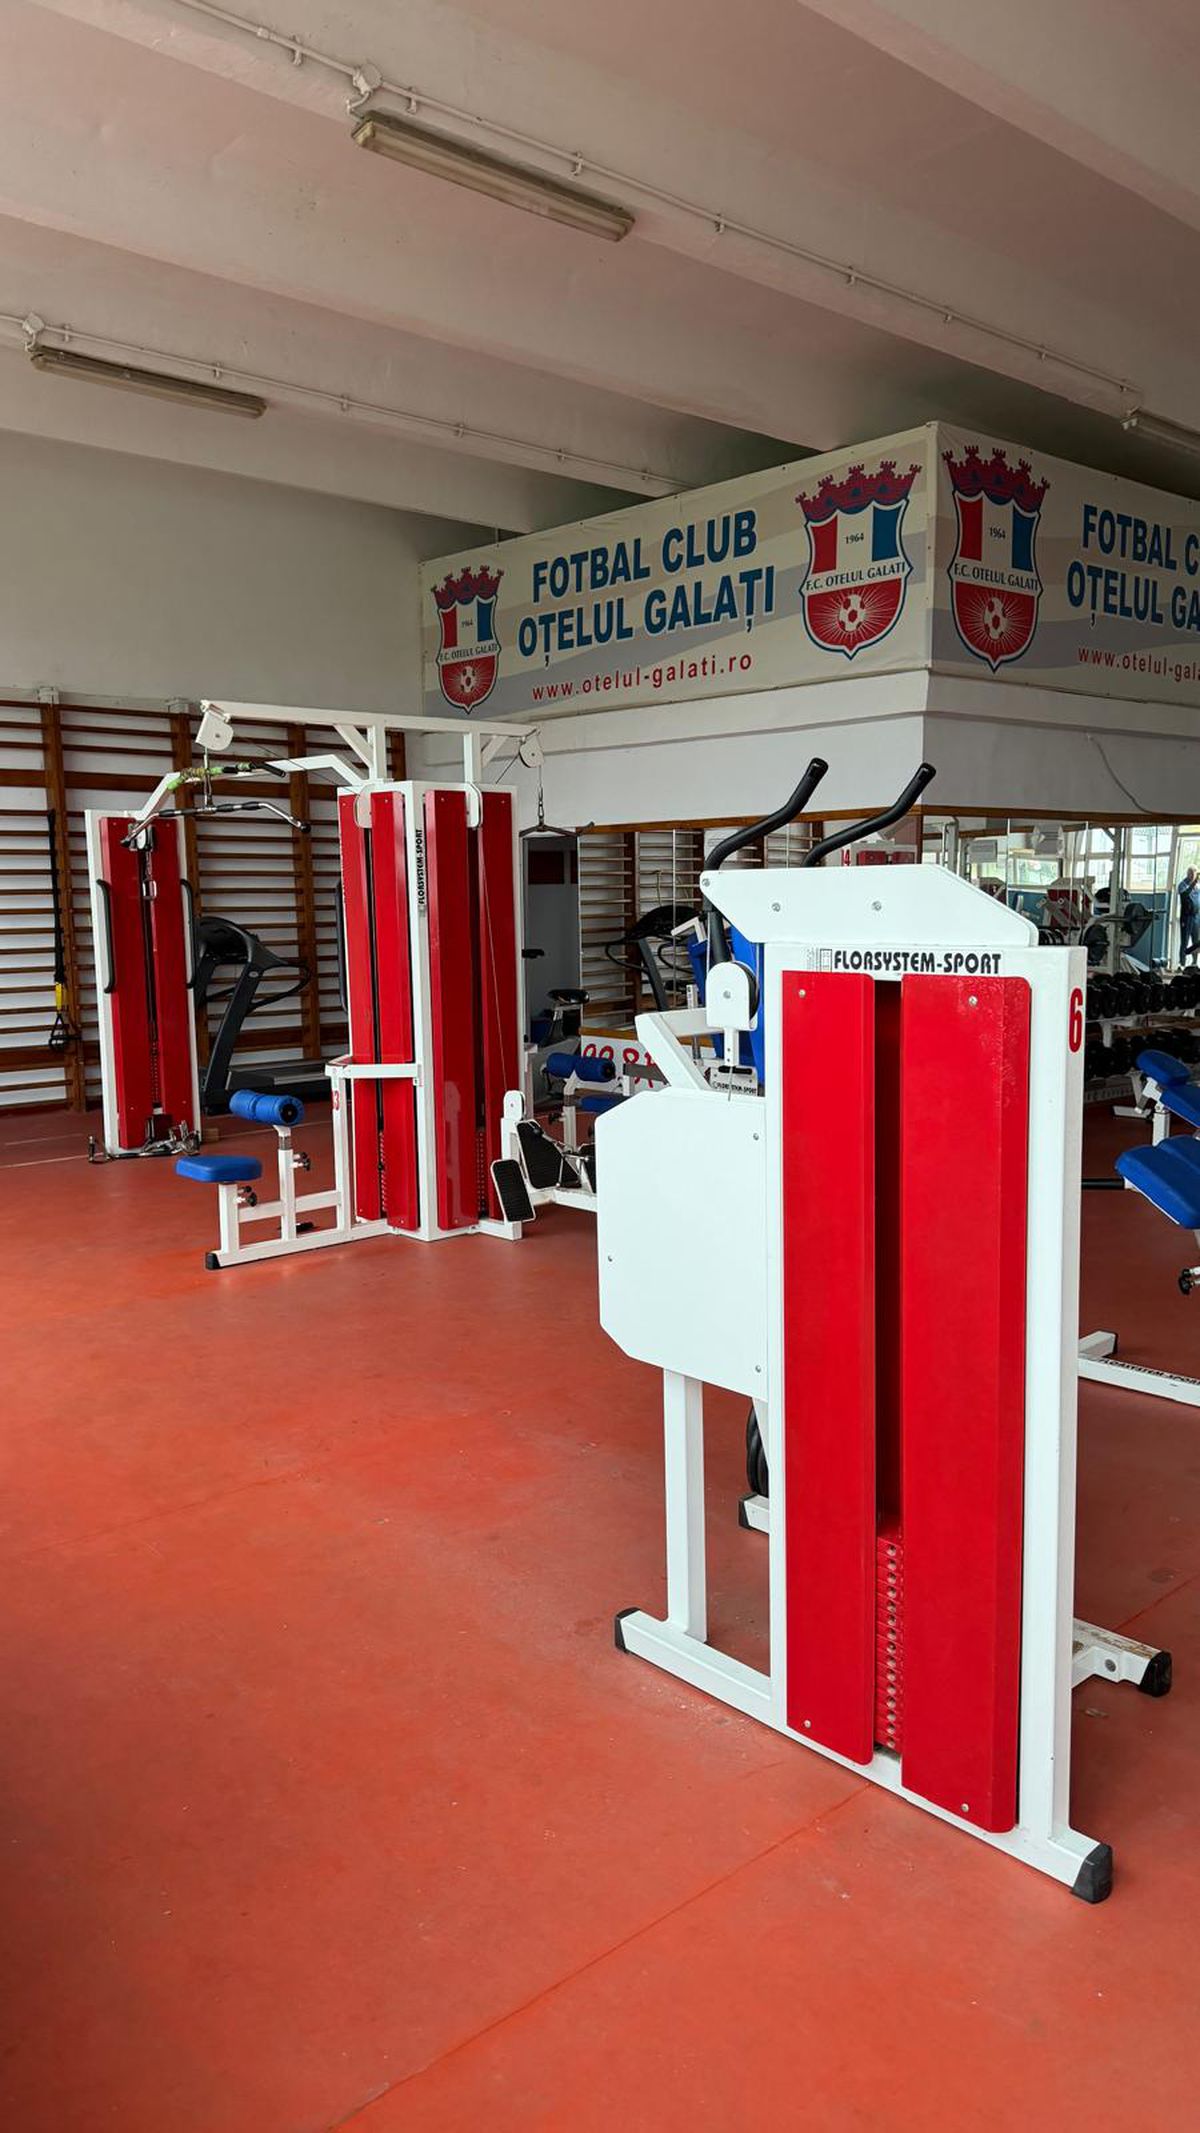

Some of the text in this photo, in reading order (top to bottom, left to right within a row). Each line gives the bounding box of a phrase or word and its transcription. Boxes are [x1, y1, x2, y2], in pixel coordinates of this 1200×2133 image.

[845, 533, 864, 544] 1964
[989, 527, 1006, 539] 1964
[1082, 504, 1177, 571] FOTBAL
[533, 510, 757, 603] FOTBAL CLUB
[806, 562, 906, 591] F.C. OTELUL GALATI
[954, 563, 1039, 591] F.C. OTELUL GALATI
[518, 565, 774, 666] OȚELUL GALAȚI
[1067, 561, 1163, 626] OȚELUL
[532, 654, 752, 700] www.otelul-galati.ro
[833, 949, 1002, 975] FLORSYSTEM-SPORT
[1069, 988, 1084, 1053] 6
